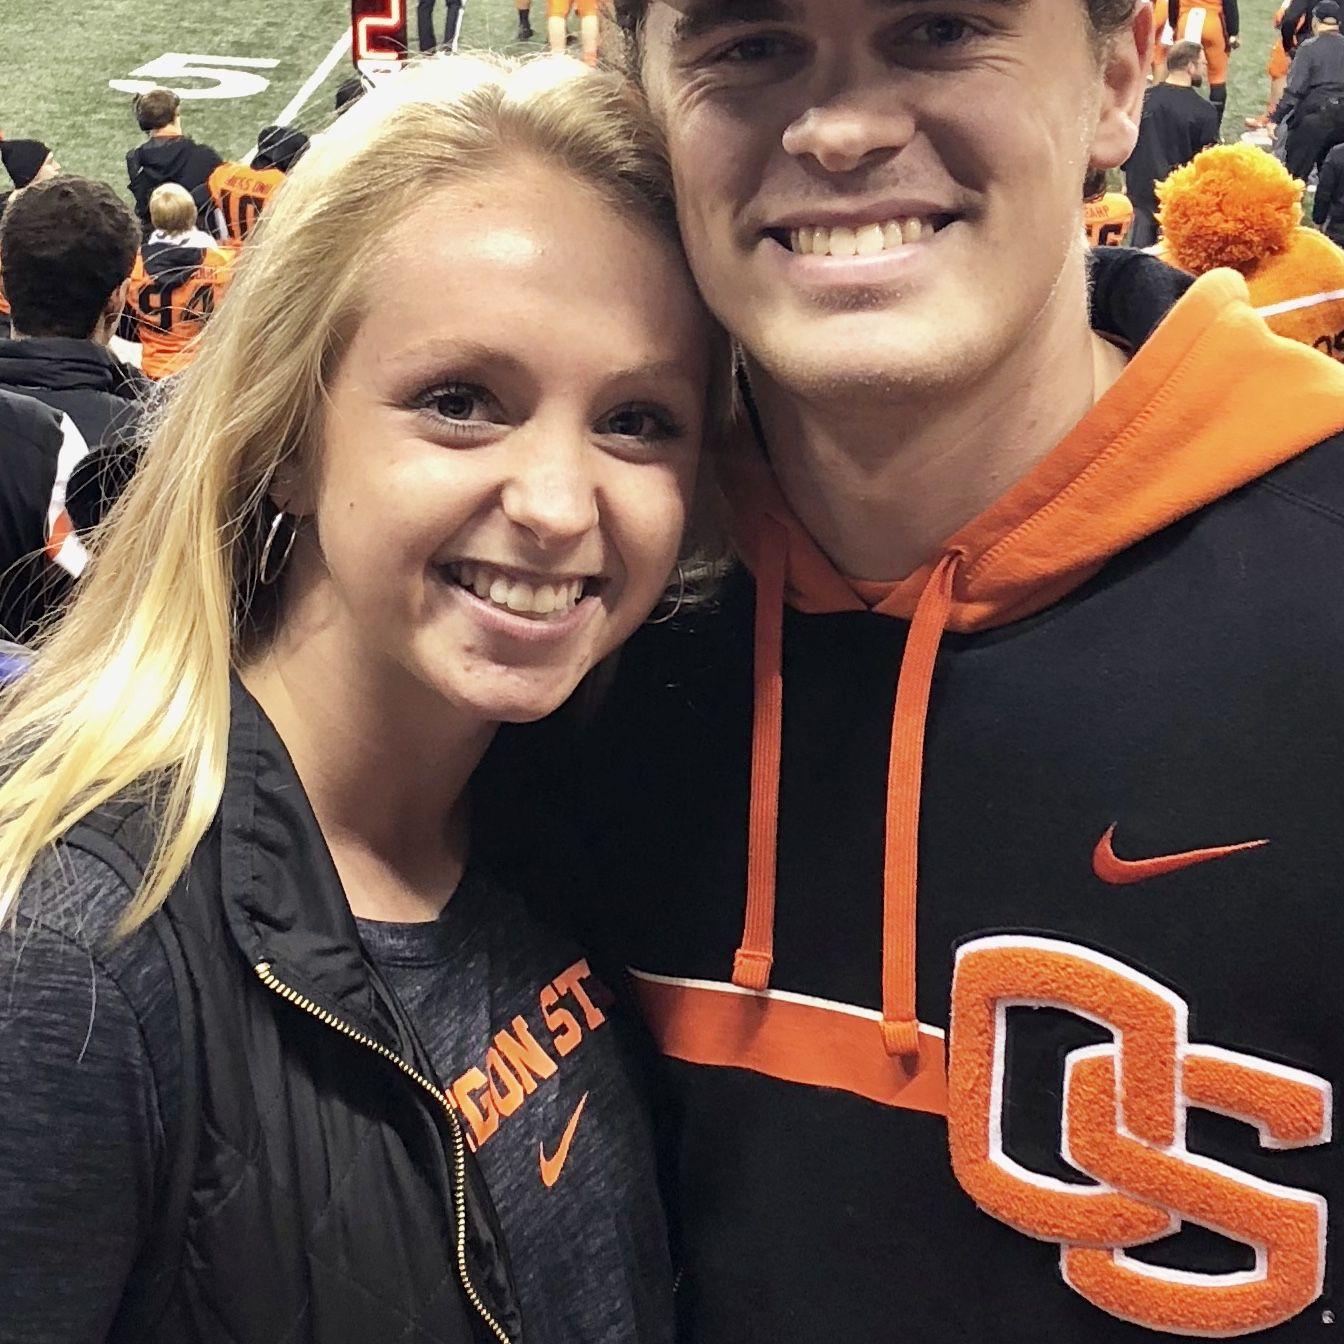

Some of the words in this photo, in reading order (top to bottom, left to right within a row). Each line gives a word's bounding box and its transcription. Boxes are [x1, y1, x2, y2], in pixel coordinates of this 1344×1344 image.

[108, 52, 281, 100] 5
[445, 1014, 558, 1154] GON
[947, 933, 1335, 1340] OS
